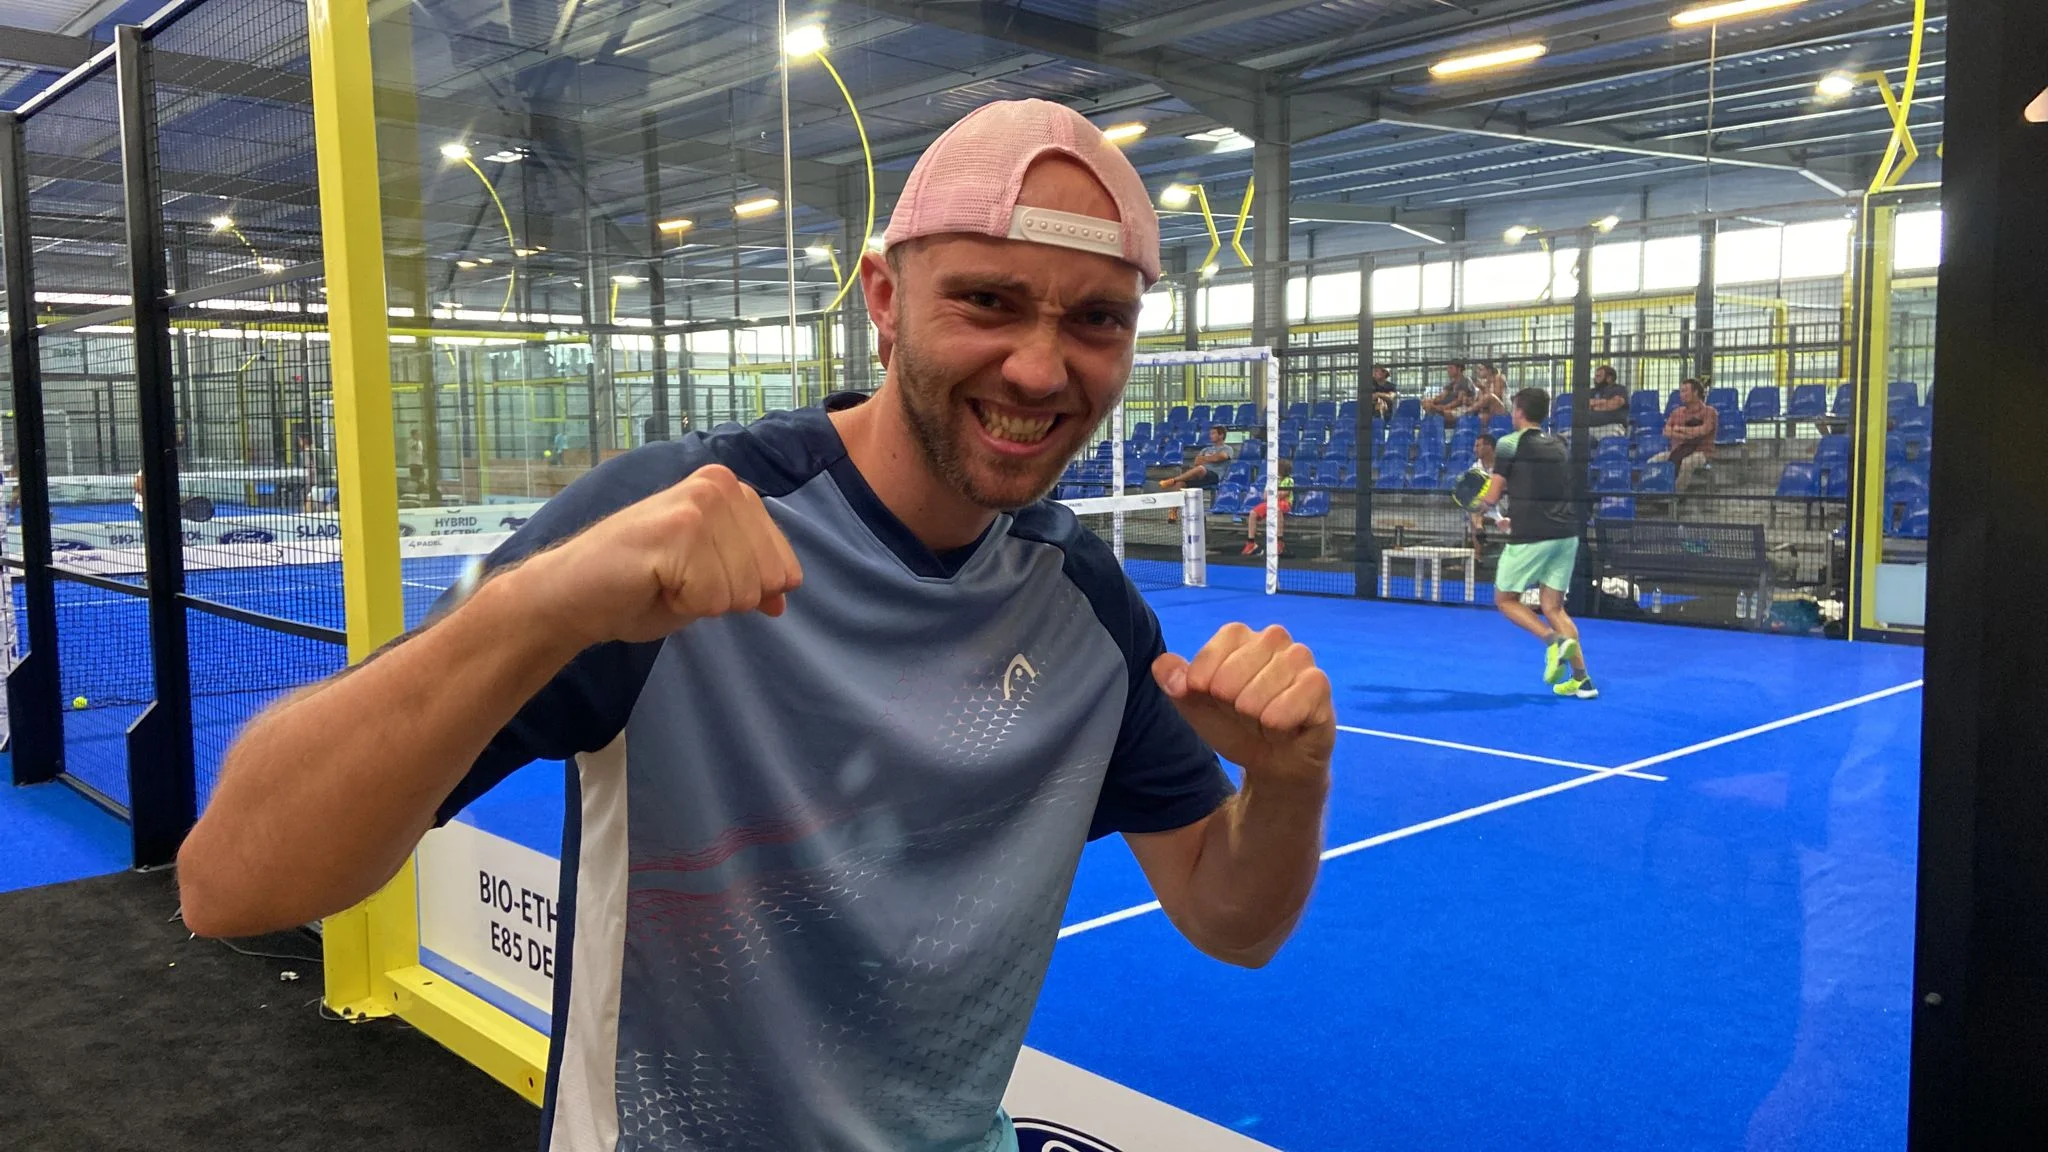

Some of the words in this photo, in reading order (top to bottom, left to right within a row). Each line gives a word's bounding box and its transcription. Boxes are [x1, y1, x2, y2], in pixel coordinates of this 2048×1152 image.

[296, 523, 342, 539] SLAD
[435, 516, 477, 528] HYBRID
[479, 869, 560, 933] BIO-ETH
[490, 920, 523, 962] E85
